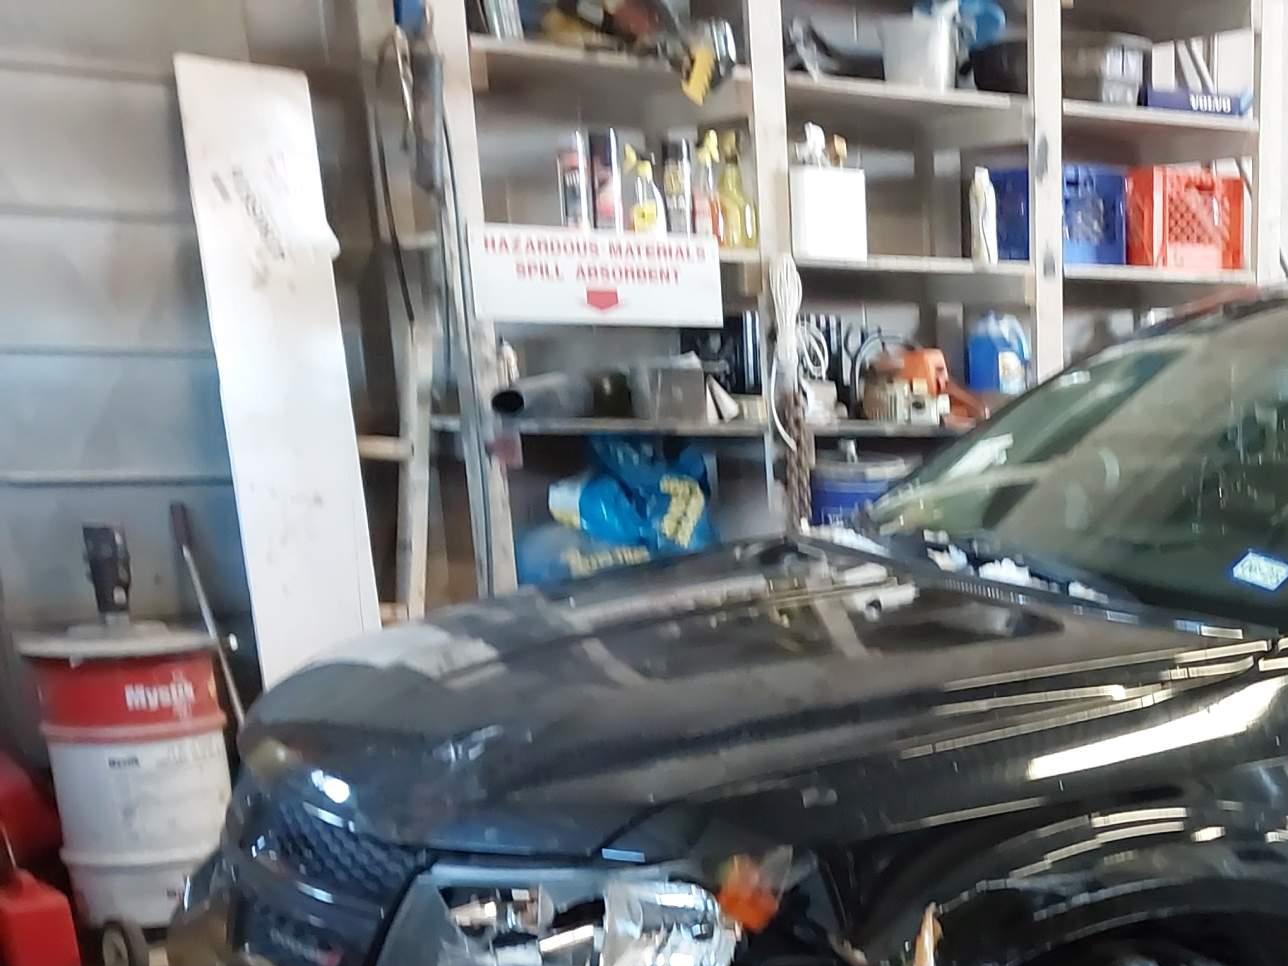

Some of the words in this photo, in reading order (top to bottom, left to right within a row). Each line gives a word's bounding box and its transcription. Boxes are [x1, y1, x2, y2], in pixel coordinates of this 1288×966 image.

[1189, 94, 1231, 113] VOLVO
[483, 235, 599, 258] HAZARDOUS
[608, 239, 705, 262] MATERIALS
[516, 263, 562, 281] SPILL
[576, 264, 679, 284] ABSORBENT
